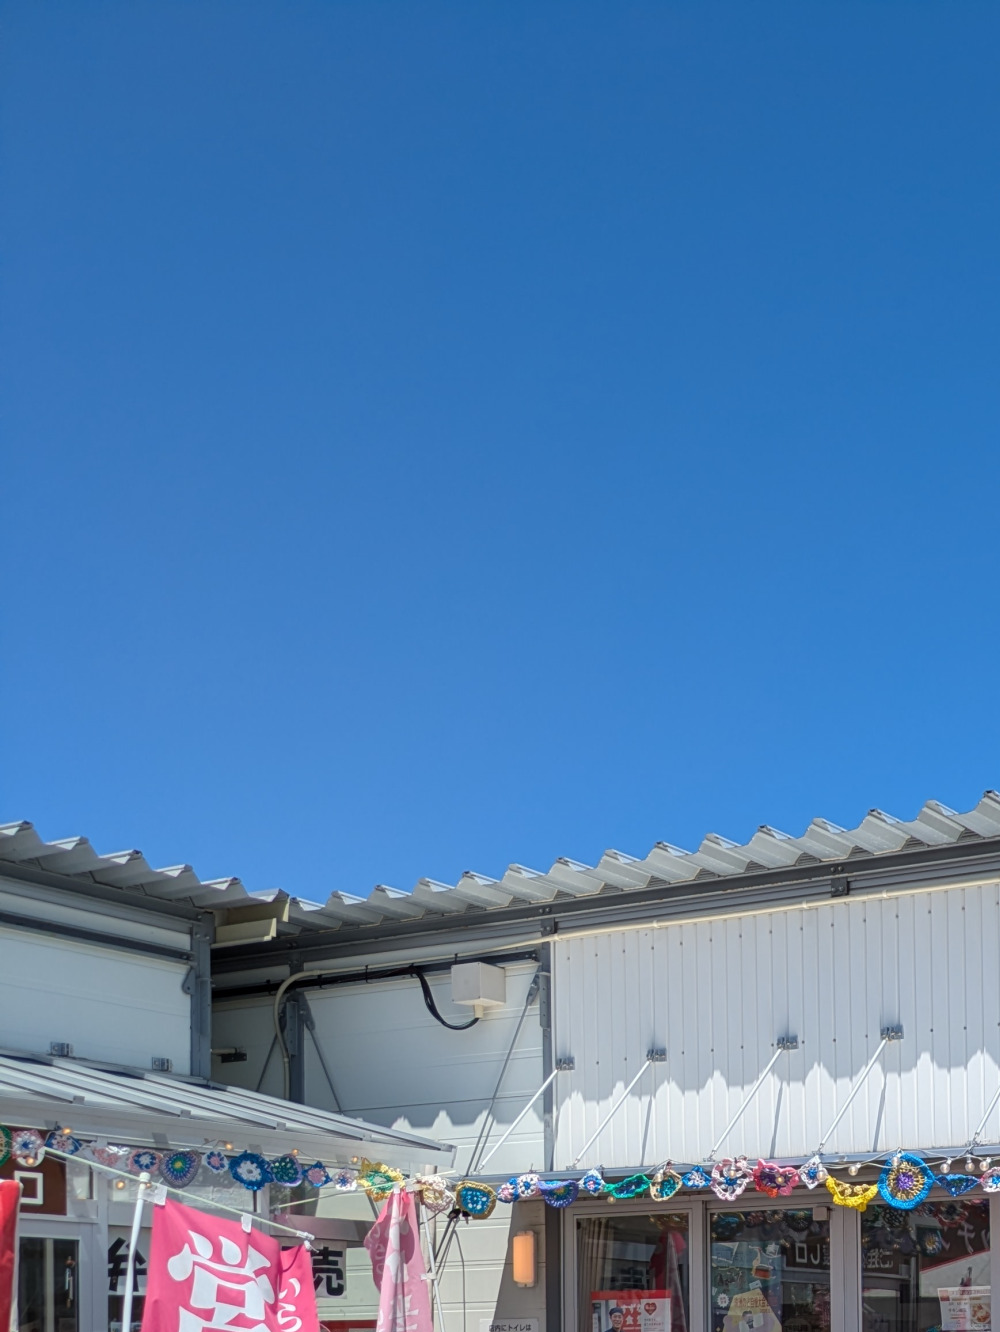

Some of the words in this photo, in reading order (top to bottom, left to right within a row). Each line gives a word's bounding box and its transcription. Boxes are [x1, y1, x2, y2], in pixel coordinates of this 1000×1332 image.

[489, 1324, 532, 1332] 店内にトイレは
